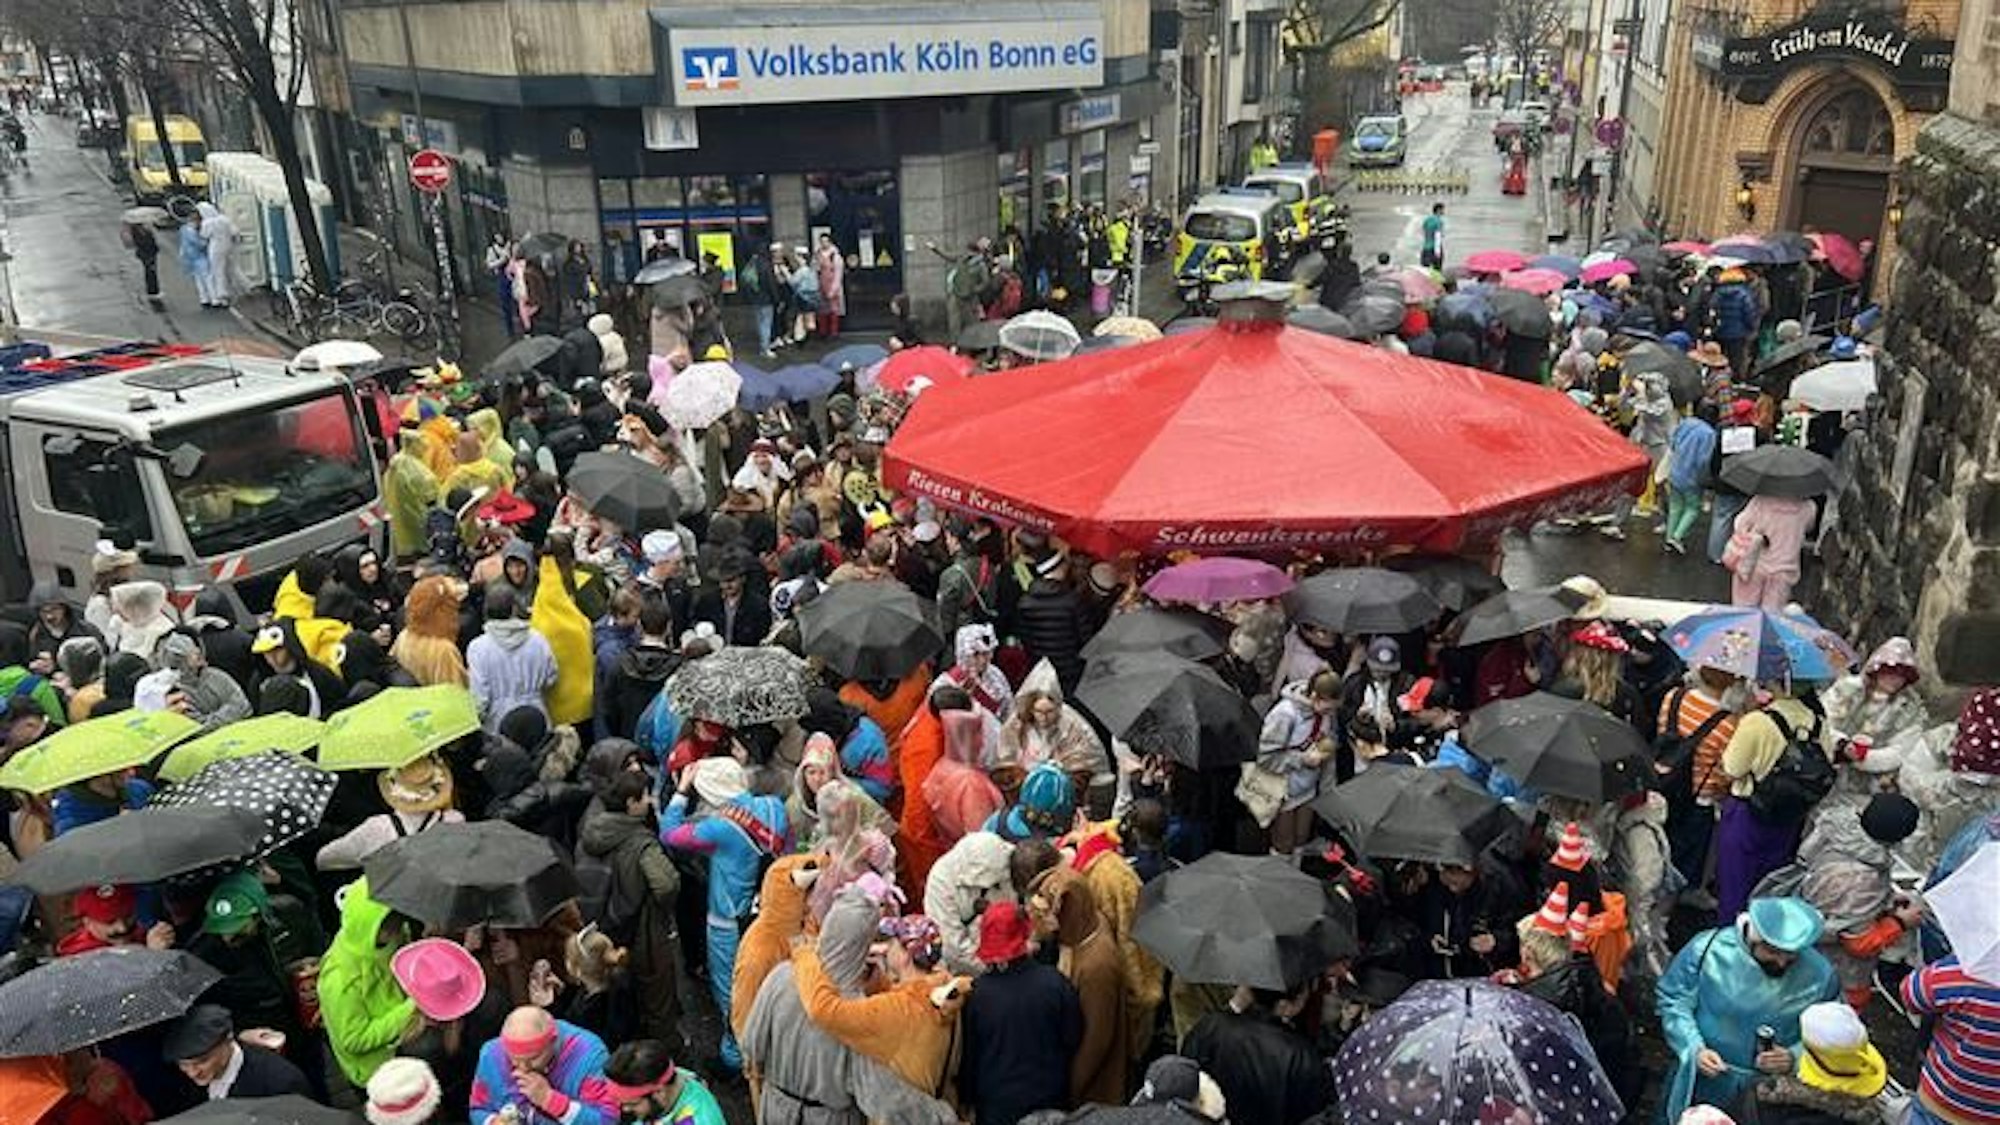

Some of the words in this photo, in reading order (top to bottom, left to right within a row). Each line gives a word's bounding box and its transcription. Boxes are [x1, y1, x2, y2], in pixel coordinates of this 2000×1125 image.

[748, 44, 907, 78] Volksbank
[916, 41, 979, 71] Köln
[989, 43, 1055, 68] Bonn
[1062, 38, 1097, 66] eG
[1817, 30, 1842, 47] em
[1845, 21, 1909, 67] Veedel
[907, 468, 962, 501] Riesen
[1153, 525, 1389, 545] Schwenksteaks
